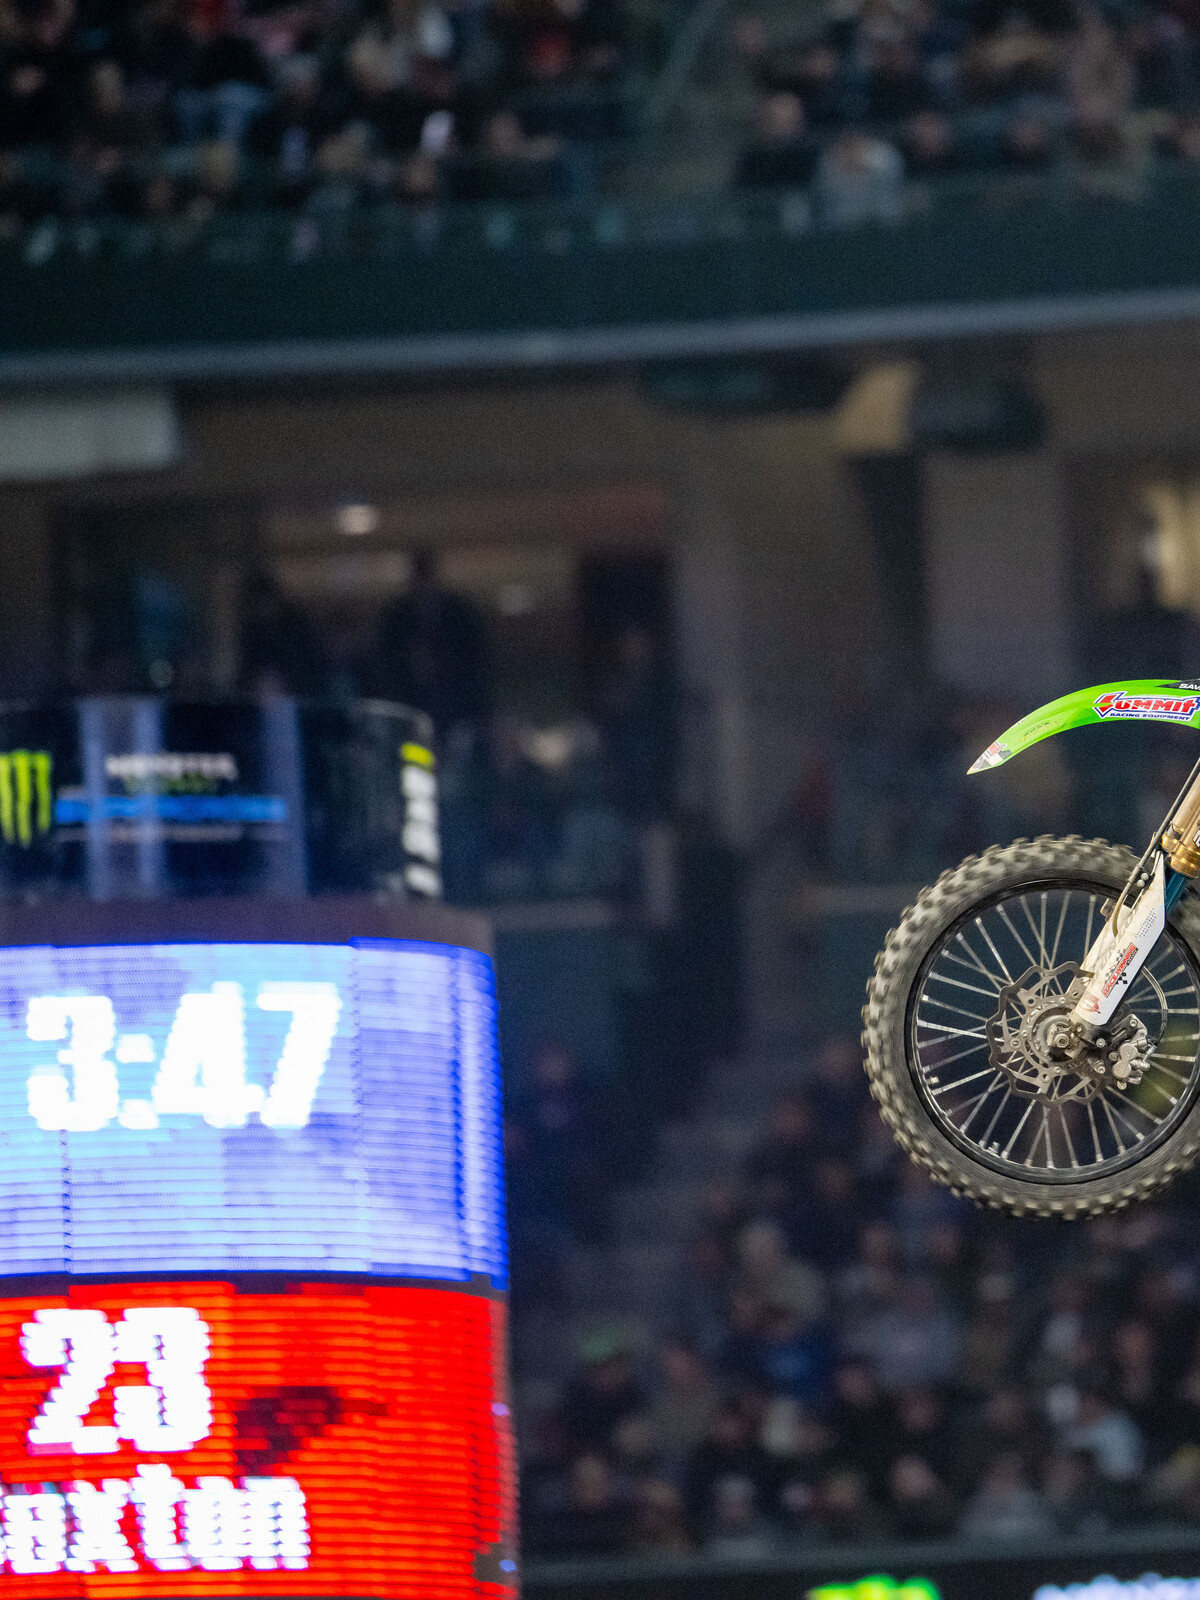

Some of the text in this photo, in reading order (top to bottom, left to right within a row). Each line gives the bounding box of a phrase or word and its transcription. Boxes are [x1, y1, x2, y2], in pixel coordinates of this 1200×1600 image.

[1142, 713, 1191, 721] EQUIPMENT
[26, 981, 343, 1131] 3:47
[21, 1306, 213, 1453] 23
